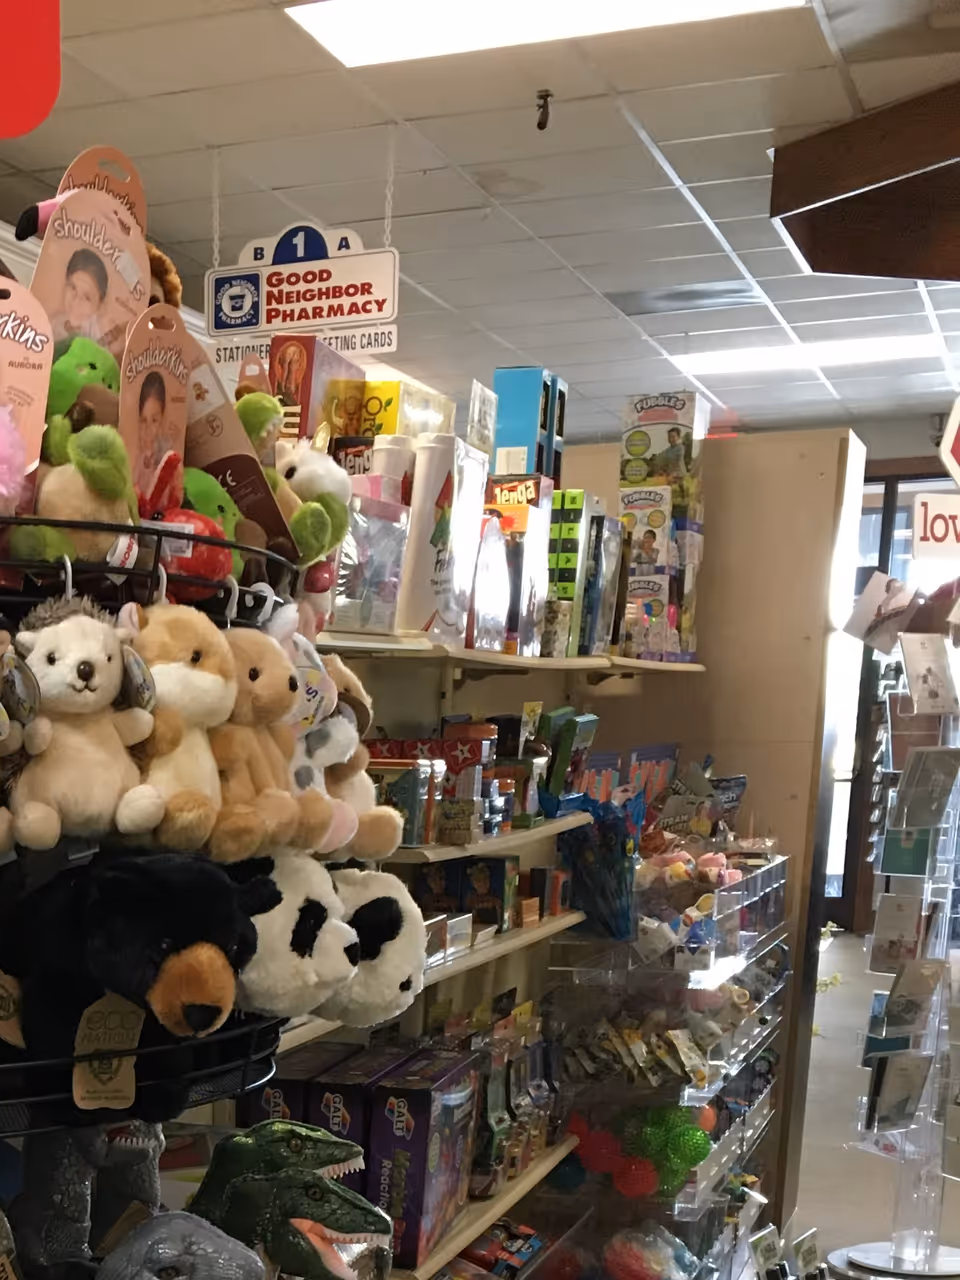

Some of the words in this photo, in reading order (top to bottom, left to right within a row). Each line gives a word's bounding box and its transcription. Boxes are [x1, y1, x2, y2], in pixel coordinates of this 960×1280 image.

[253, 246, 265, 261] B
[292, 231, 305, 258] 1
[337, 236, 351, 252] A
[265, 268, 333, 288] GOOD
[265, 281, 374, 307] NEIGHBOR
[265, 298, 388, 325] PHARMACY
[359, 331, 393, 350] CARDS
[126, 336, 189, 385] shoulderkins
[338, 448, 374, 475] Jeng
[494, 479, 537, 505] Jenga
[628, 580, 662, 593] UBBLES
[331, 1094, 344, 1131] GALT
[394, 1098, 408, 1137] GALT
[377, 1159, 392, 1212] Reactio
